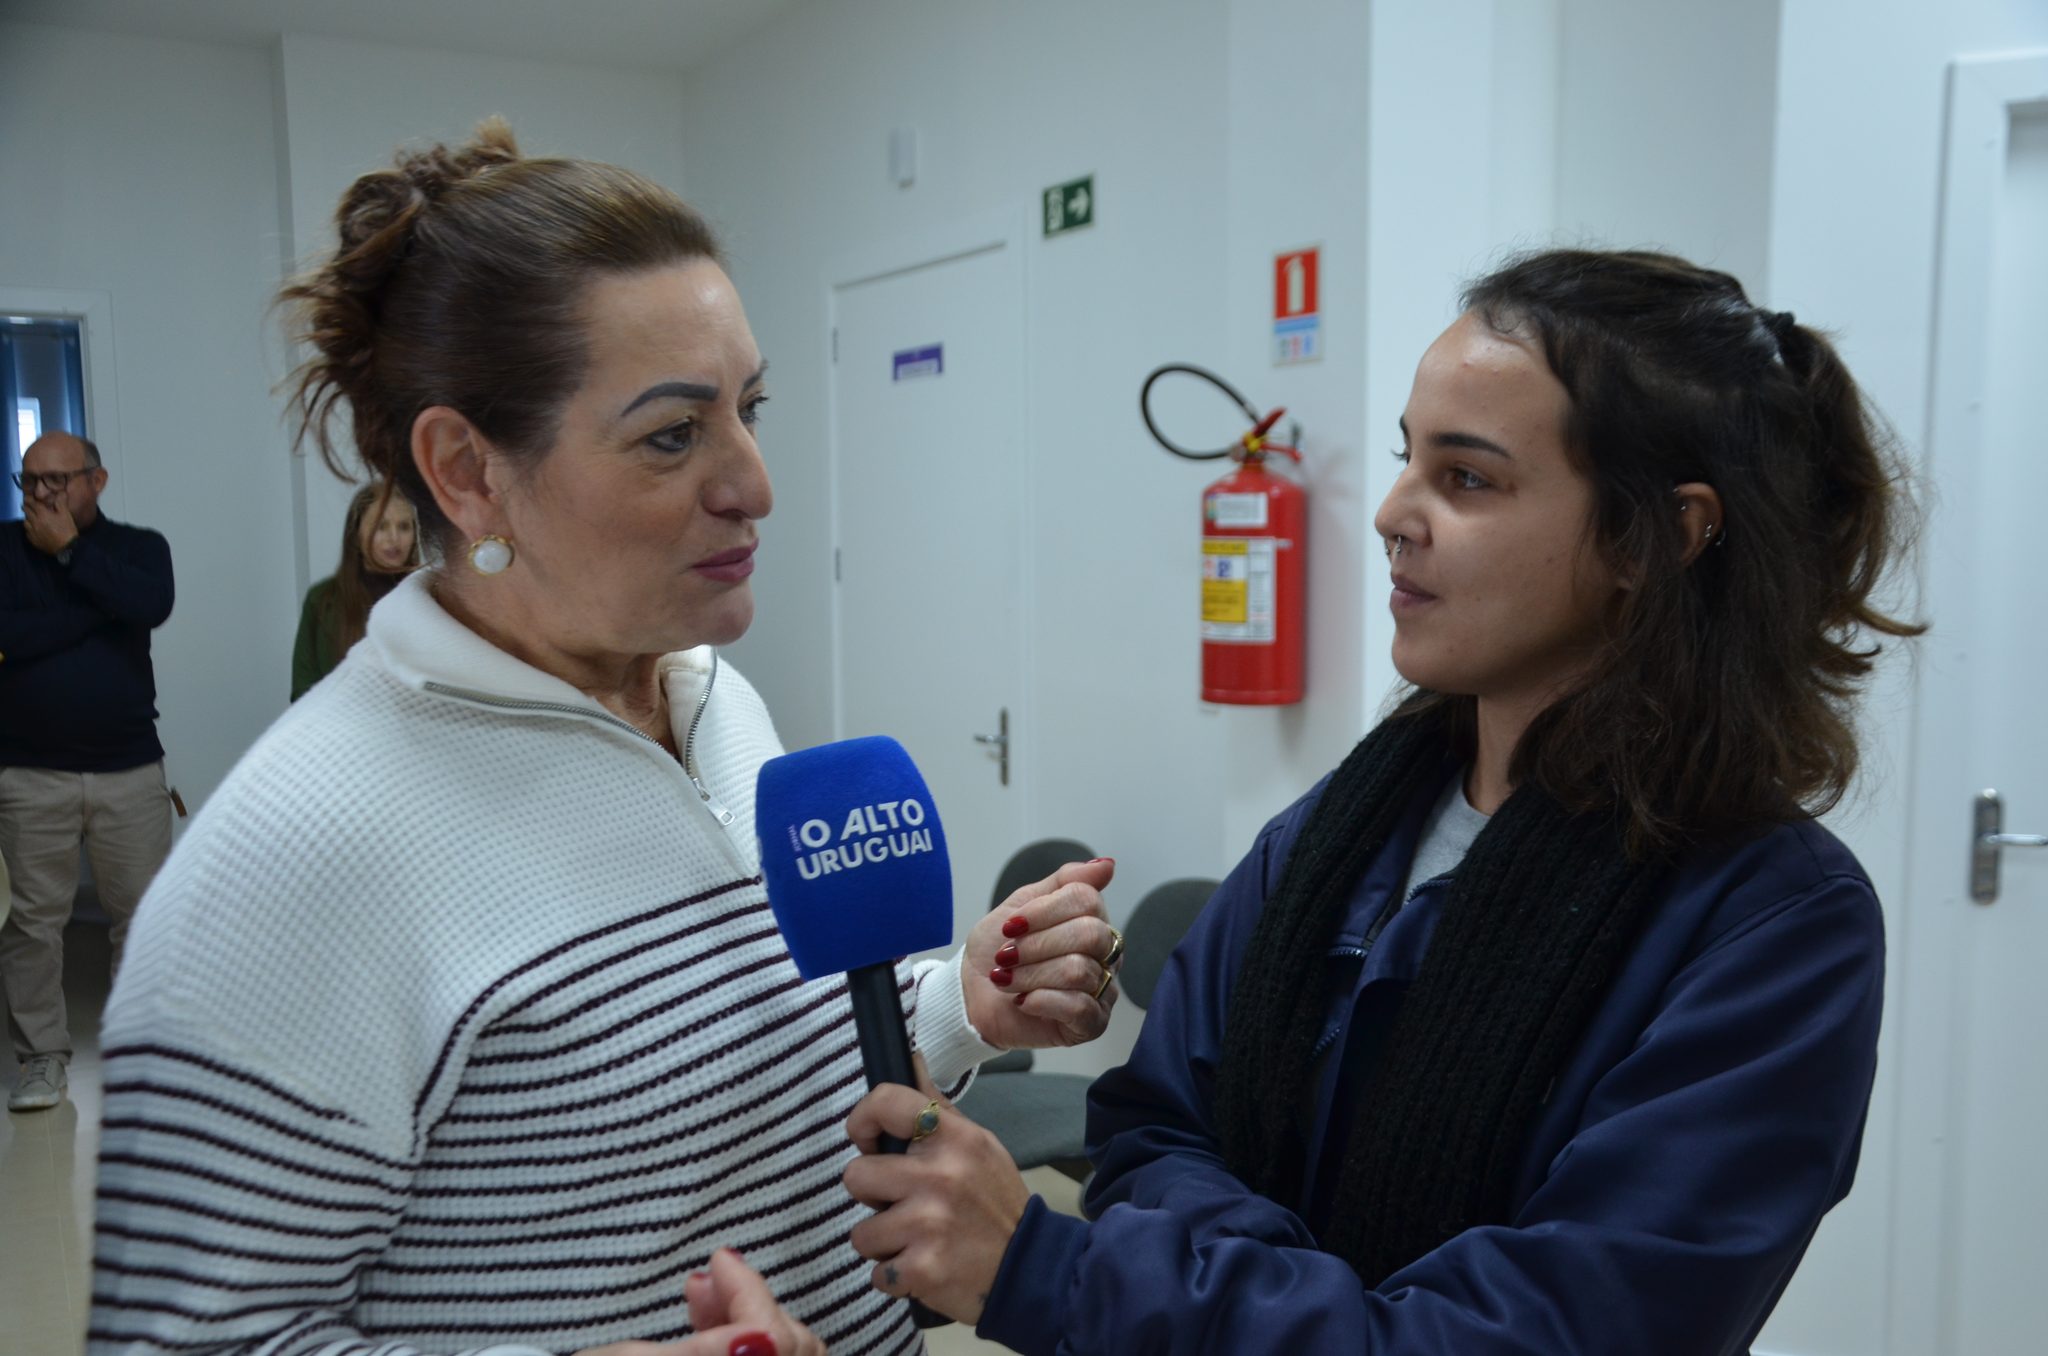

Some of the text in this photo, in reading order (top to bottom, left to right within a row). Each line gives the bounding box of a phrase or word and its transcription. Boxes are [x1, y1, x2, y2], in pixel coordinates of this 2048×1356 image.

[800, 798, 925, 848] O ALTO
[796, 828, 933, 880] URUGUAI
